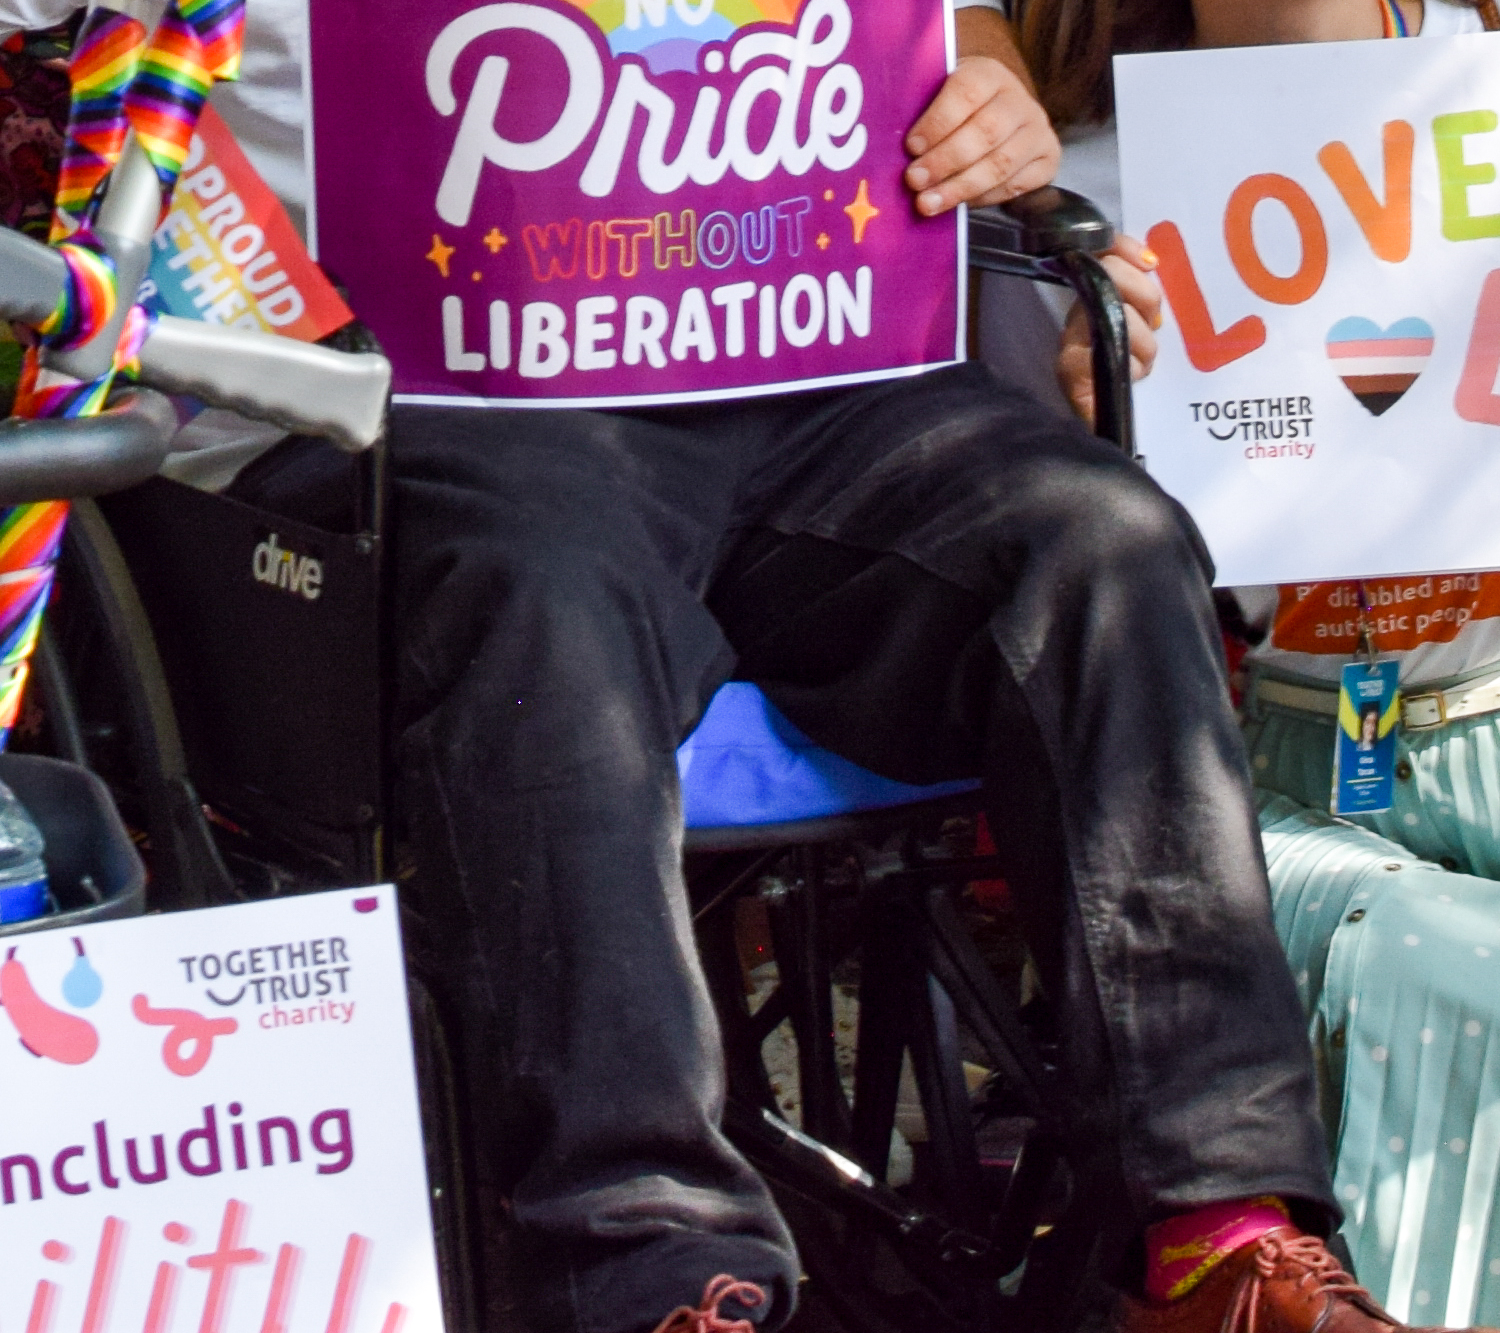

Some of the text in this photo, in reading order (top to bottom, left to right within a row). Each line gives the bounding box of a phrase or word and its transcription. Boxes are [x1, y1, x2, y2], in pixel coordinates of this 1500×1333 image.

[181, 166, 306, 328] PROUD
[521, 194, 811, 283] WITHOUT
[442, 264, 874, 379] LIBERATION
[1190, 395, 1314, 423] TOGETHER
[1240, 418, 1313, 440] TRUST
[1244, 439, 1317, 461] charity
[252, 533, 324, 600] drive
[178, 935, 350, 984] TOGETHER
[249, 966, 353, 1006] TRUST
[257, 998, 357, 1031] charity
